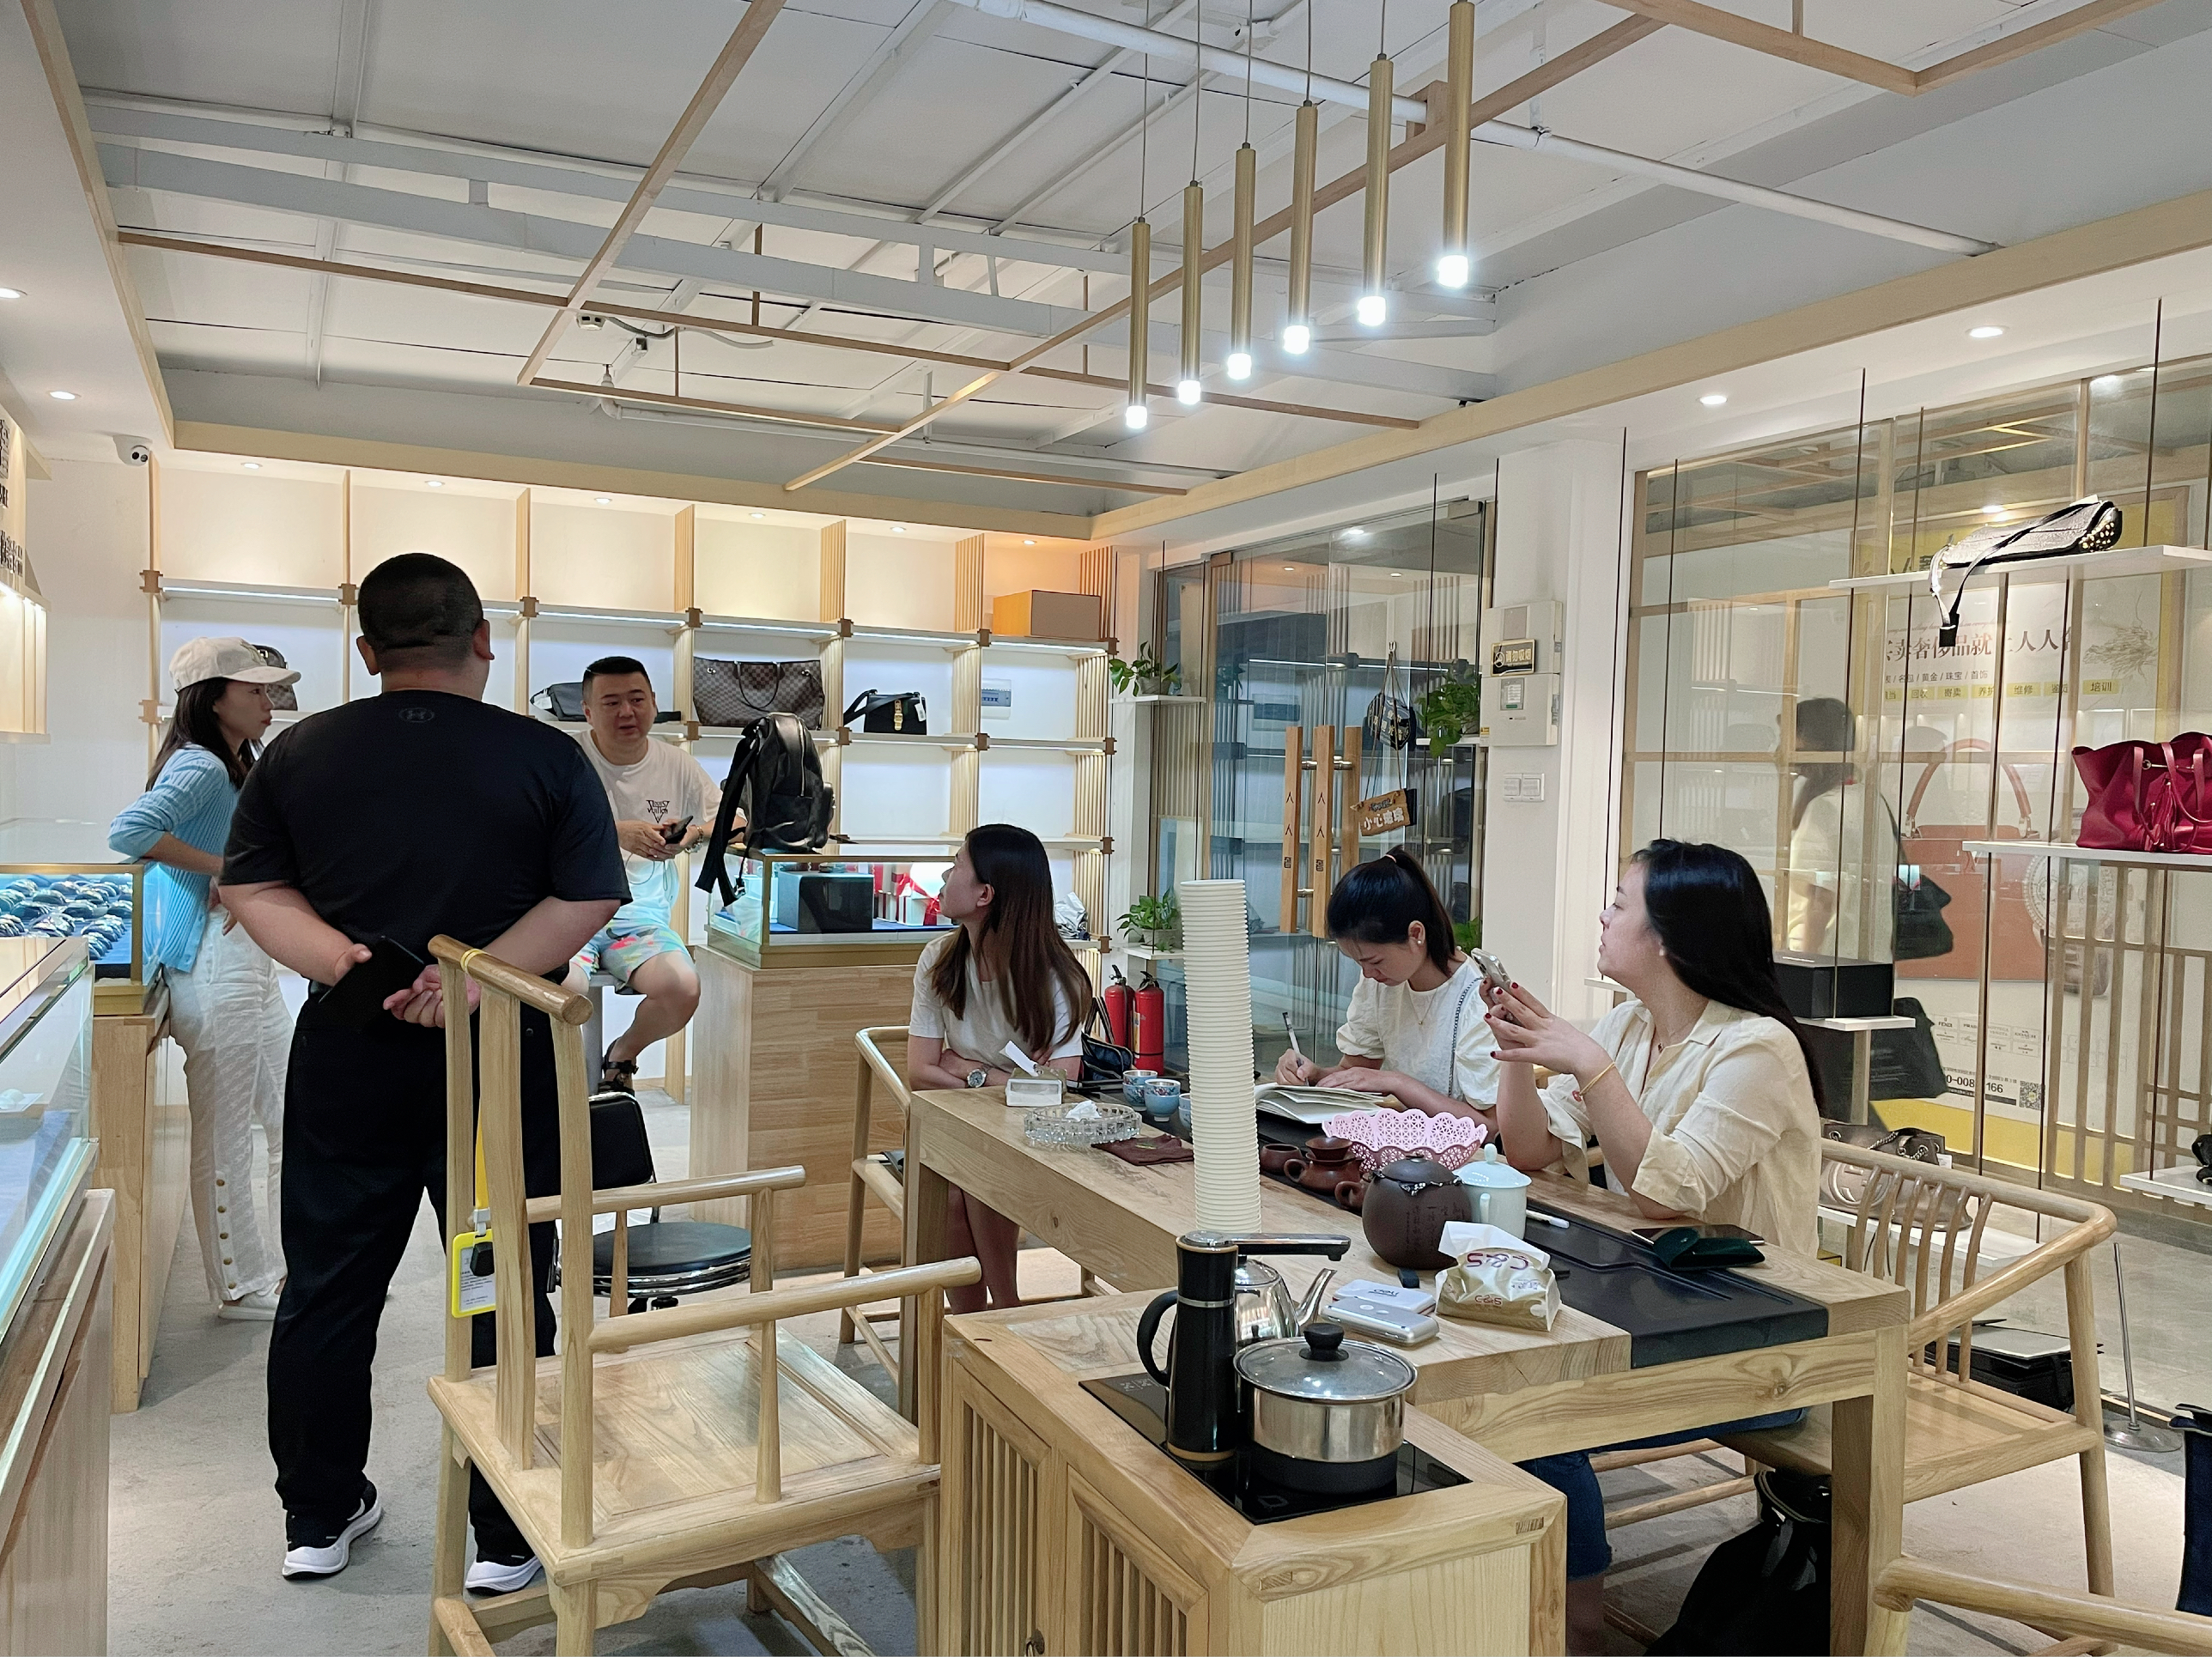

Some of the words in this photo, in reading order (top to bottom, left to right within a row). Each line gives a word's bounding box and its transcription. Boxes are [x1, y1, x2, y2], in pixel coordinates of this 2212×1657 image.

[1505, 648, 1532, 663] 请勿吸烟
[1911, 689, 1928, 699] 回收
[1944, 689, 1961, 698] 寄卖
[2014, 684, 2033, 695] 维修
[2090, 682, 2112, 692] 培训
[1364, 807, 1405, 831] 小心玻璃
[1474, 1295, 1502, 1306] C&S
